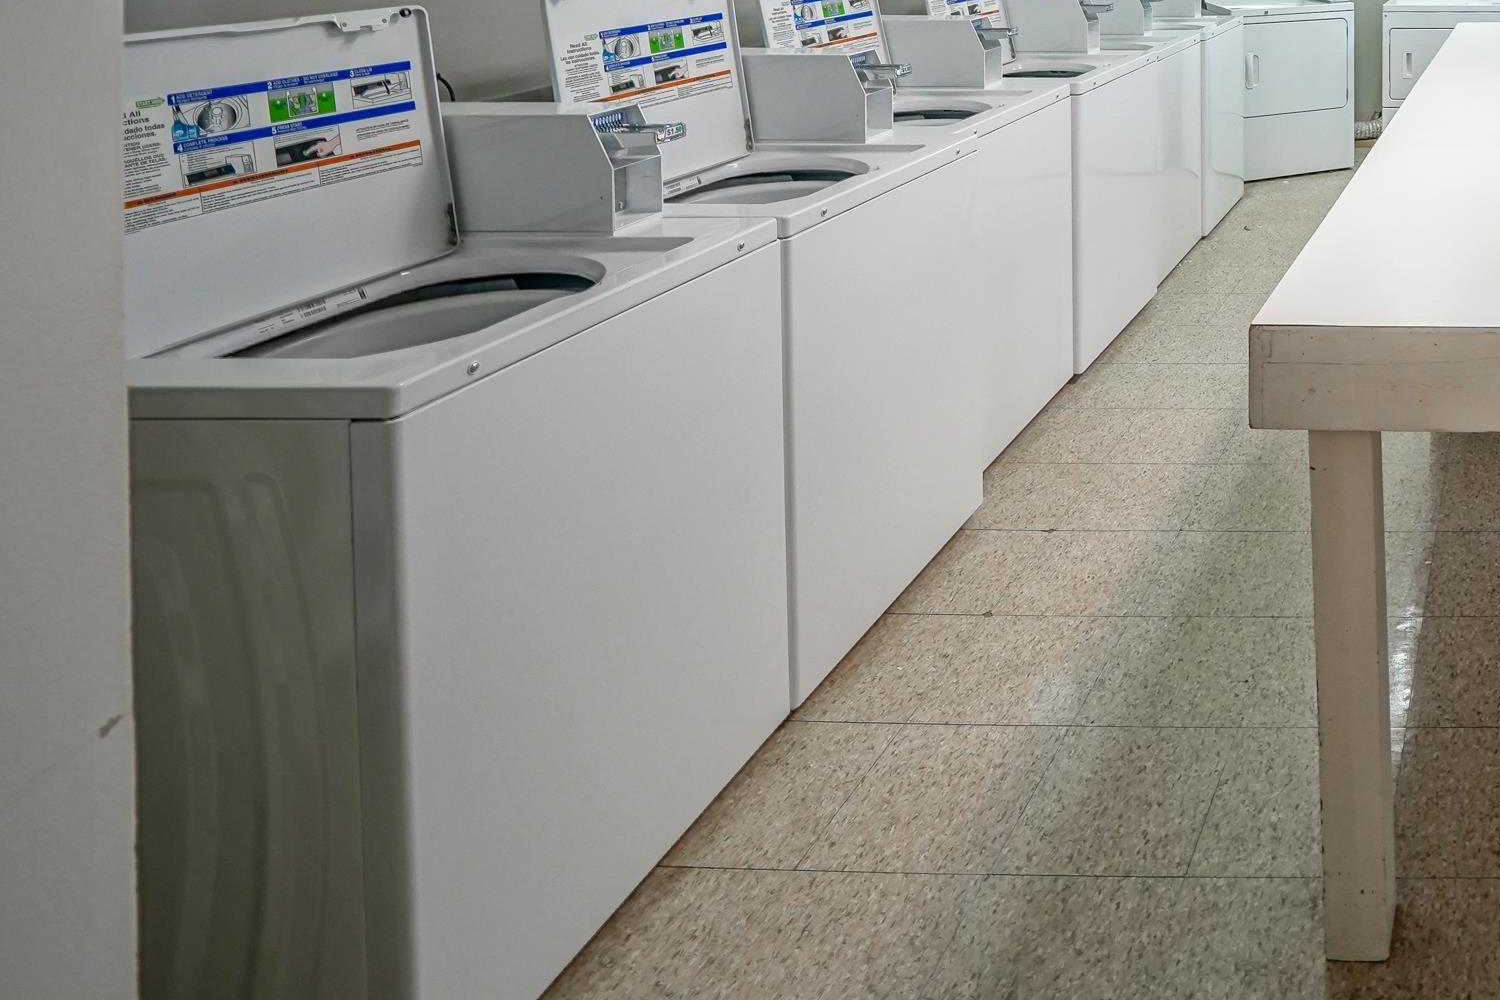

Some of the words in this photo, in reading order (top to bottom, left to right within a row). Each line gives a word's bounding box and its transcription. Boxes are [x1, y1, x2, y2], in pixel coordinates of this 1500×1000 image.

[349, 70, 355, 78] 3
[267, 81, 273, 89] 2
[171, 95, 176, 104] 1
[271, 126, 277, 135] 5
[177, 143, 183, 152] 4
